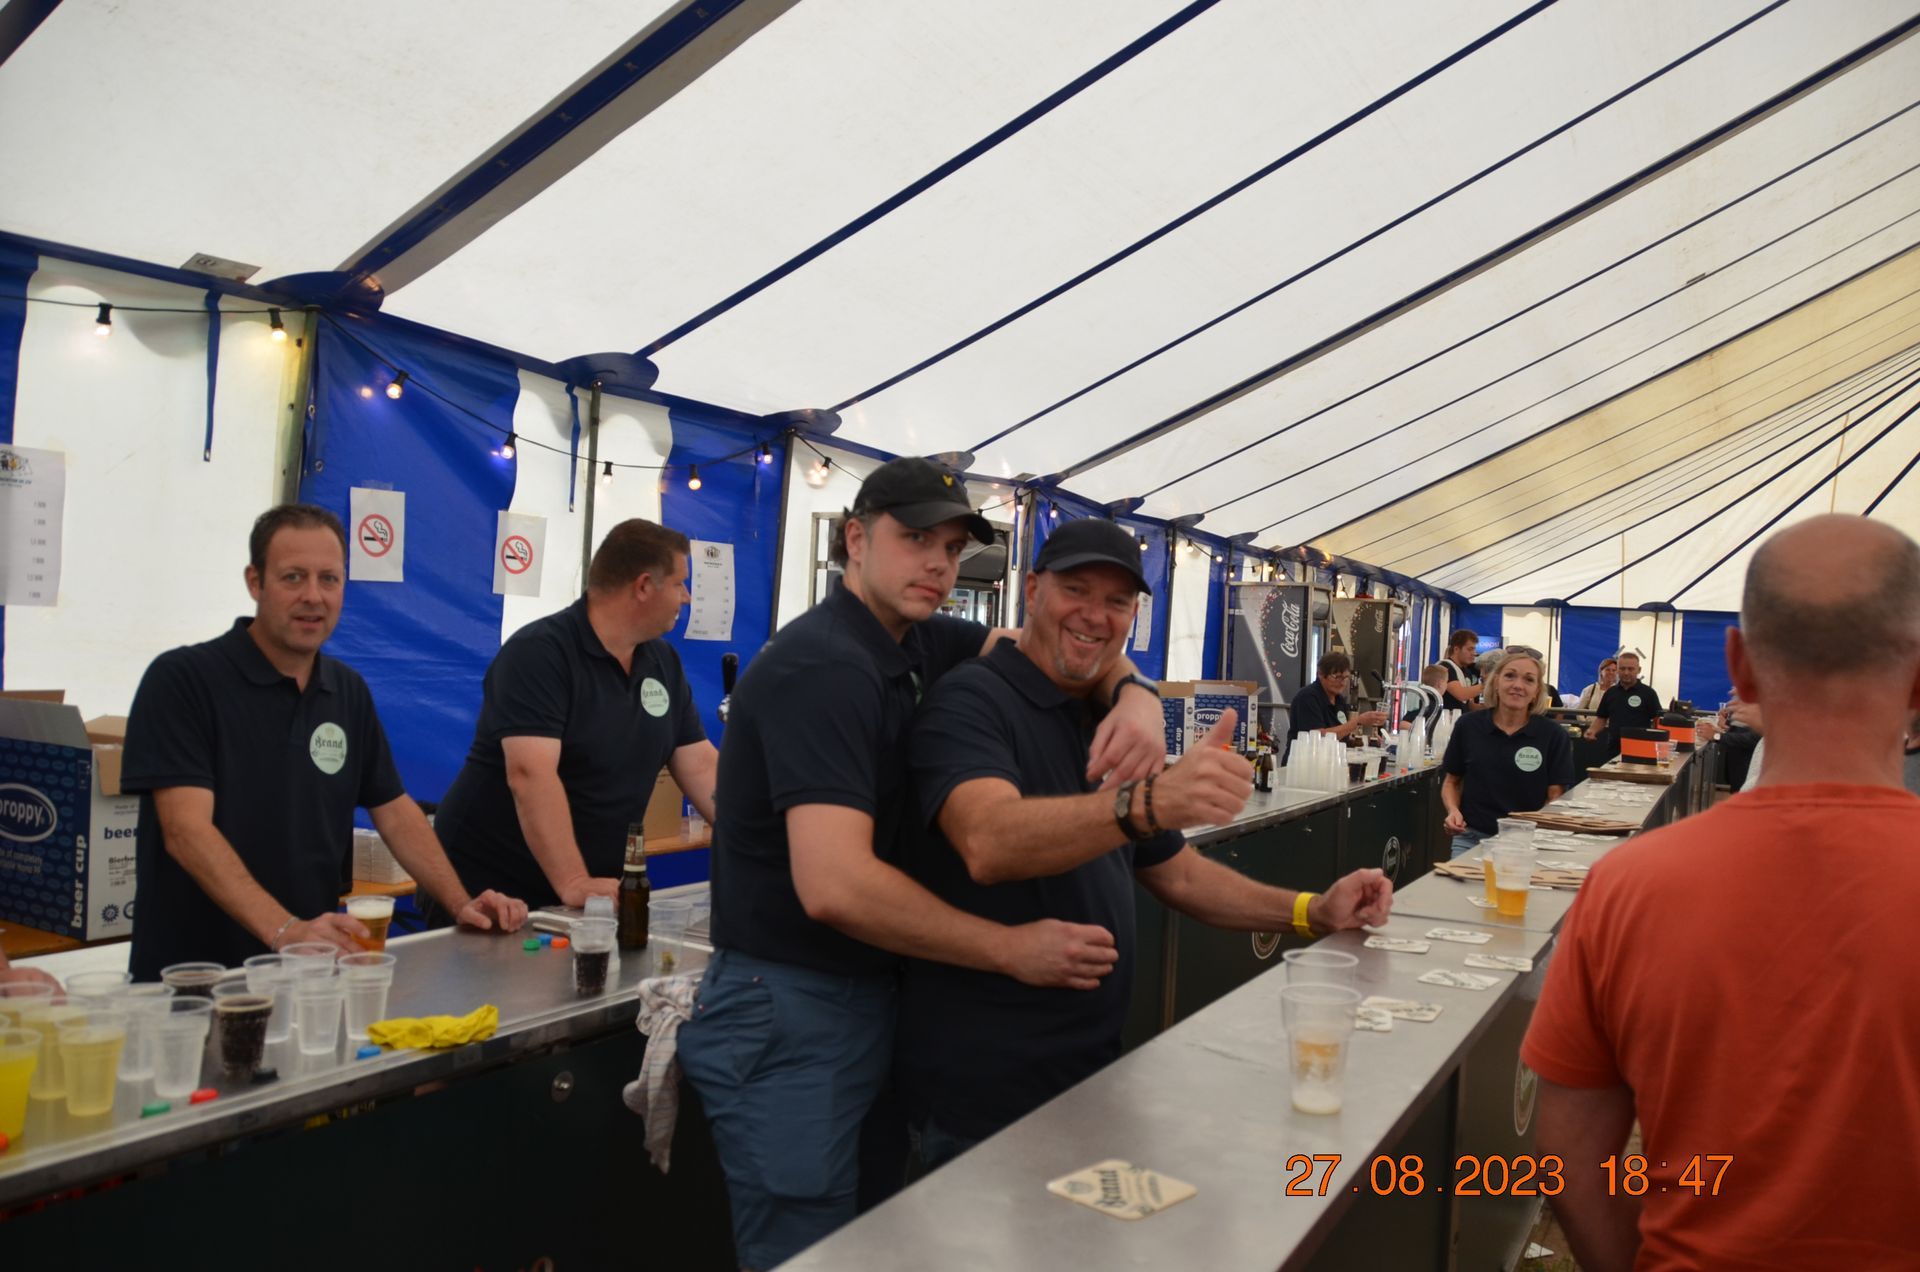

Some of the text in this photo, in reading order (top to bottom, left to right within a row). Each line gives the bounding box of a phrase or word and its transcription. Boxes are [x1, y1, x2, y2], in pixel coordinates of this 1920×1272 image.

[1280, 600, 1300, 657] Coca-Cola
[315, 735, 343, 749] Brand
[70, 834, 87, 928] beer cup
